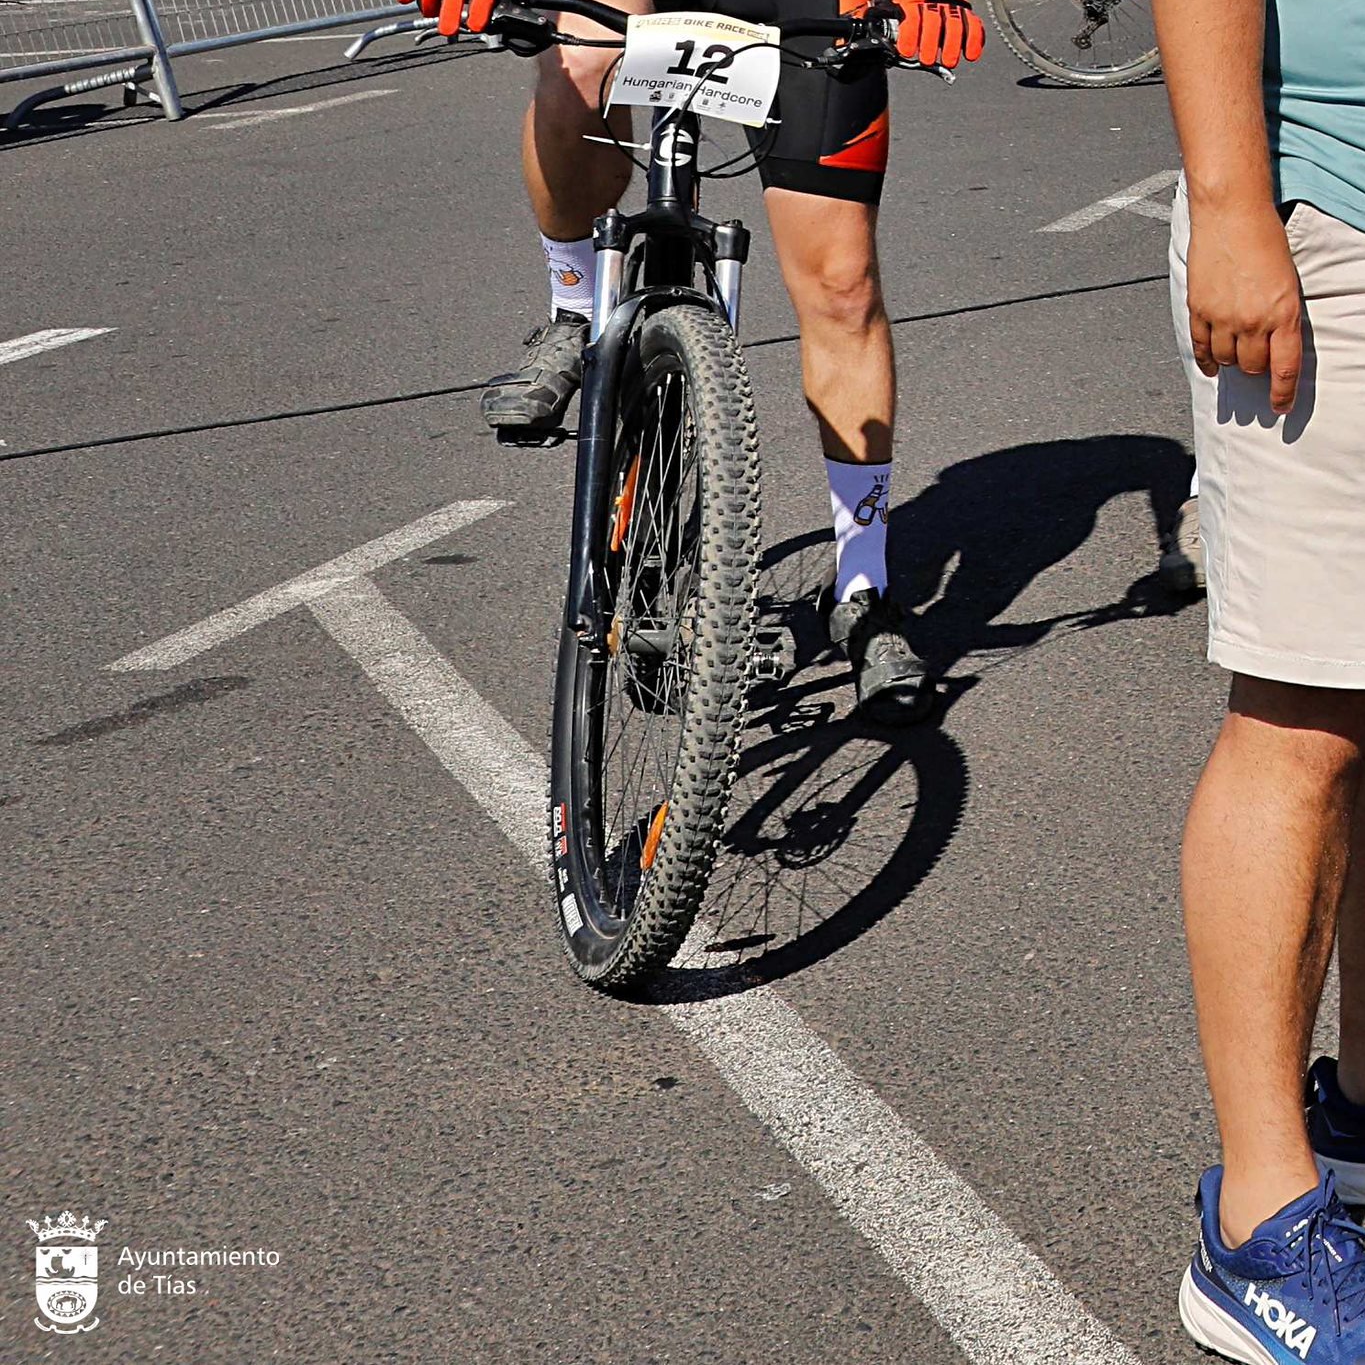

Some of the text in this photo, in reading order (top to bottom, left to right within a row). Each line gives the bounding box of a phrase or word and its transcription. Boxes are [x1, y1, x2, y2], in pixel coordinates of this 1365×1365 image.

[684, 18, 713, 28] BIKE
[716, 22, 746, 34] RACE
[667, 40, 734, 85] 12
[623, 76, 762, 108] Hungarian Hardcore
[1244, 1282, 1317, 1360] HOKA
